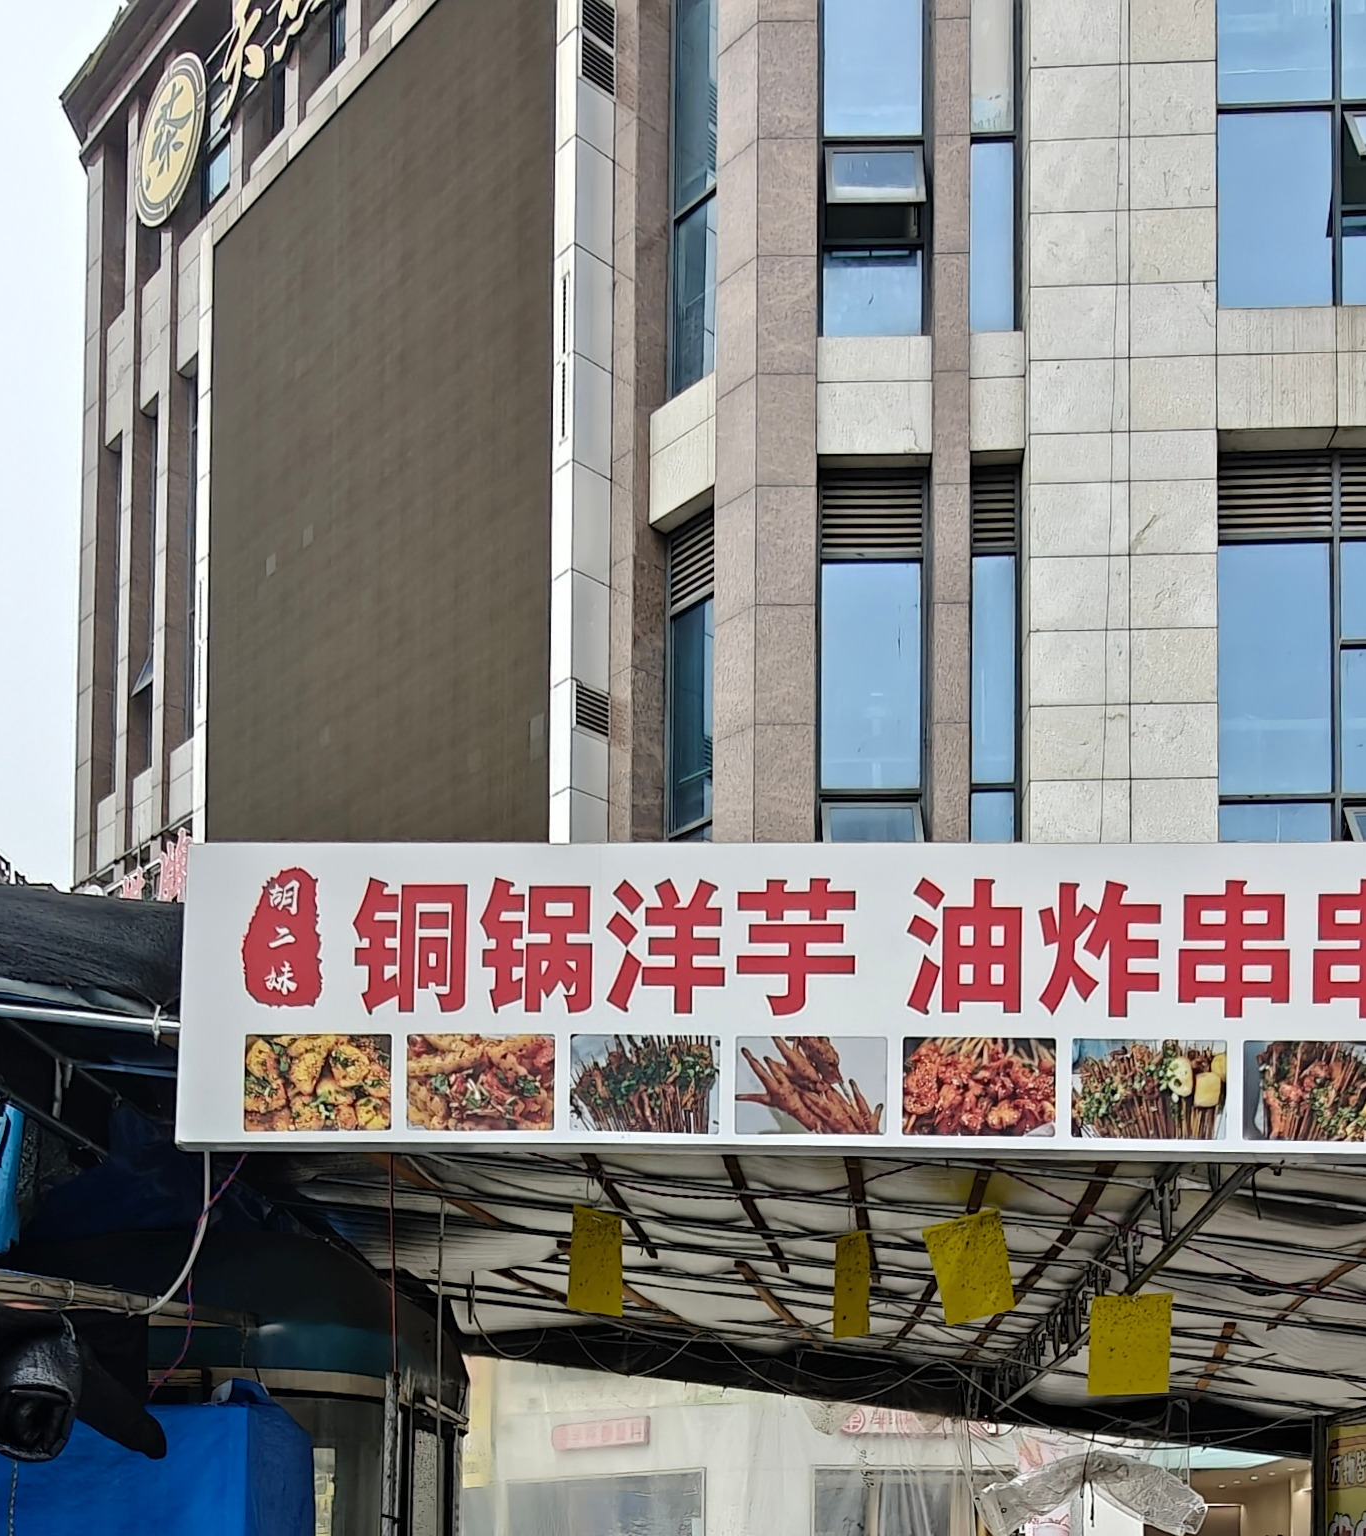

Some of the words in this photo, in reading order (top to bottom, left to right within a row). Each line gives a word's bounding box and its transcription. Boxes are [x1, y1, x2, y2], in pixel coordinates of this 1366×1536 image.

[263, 878, 300, 994] 胡二妹
[353, 876, 856, 1016] 铜锅洋芋
